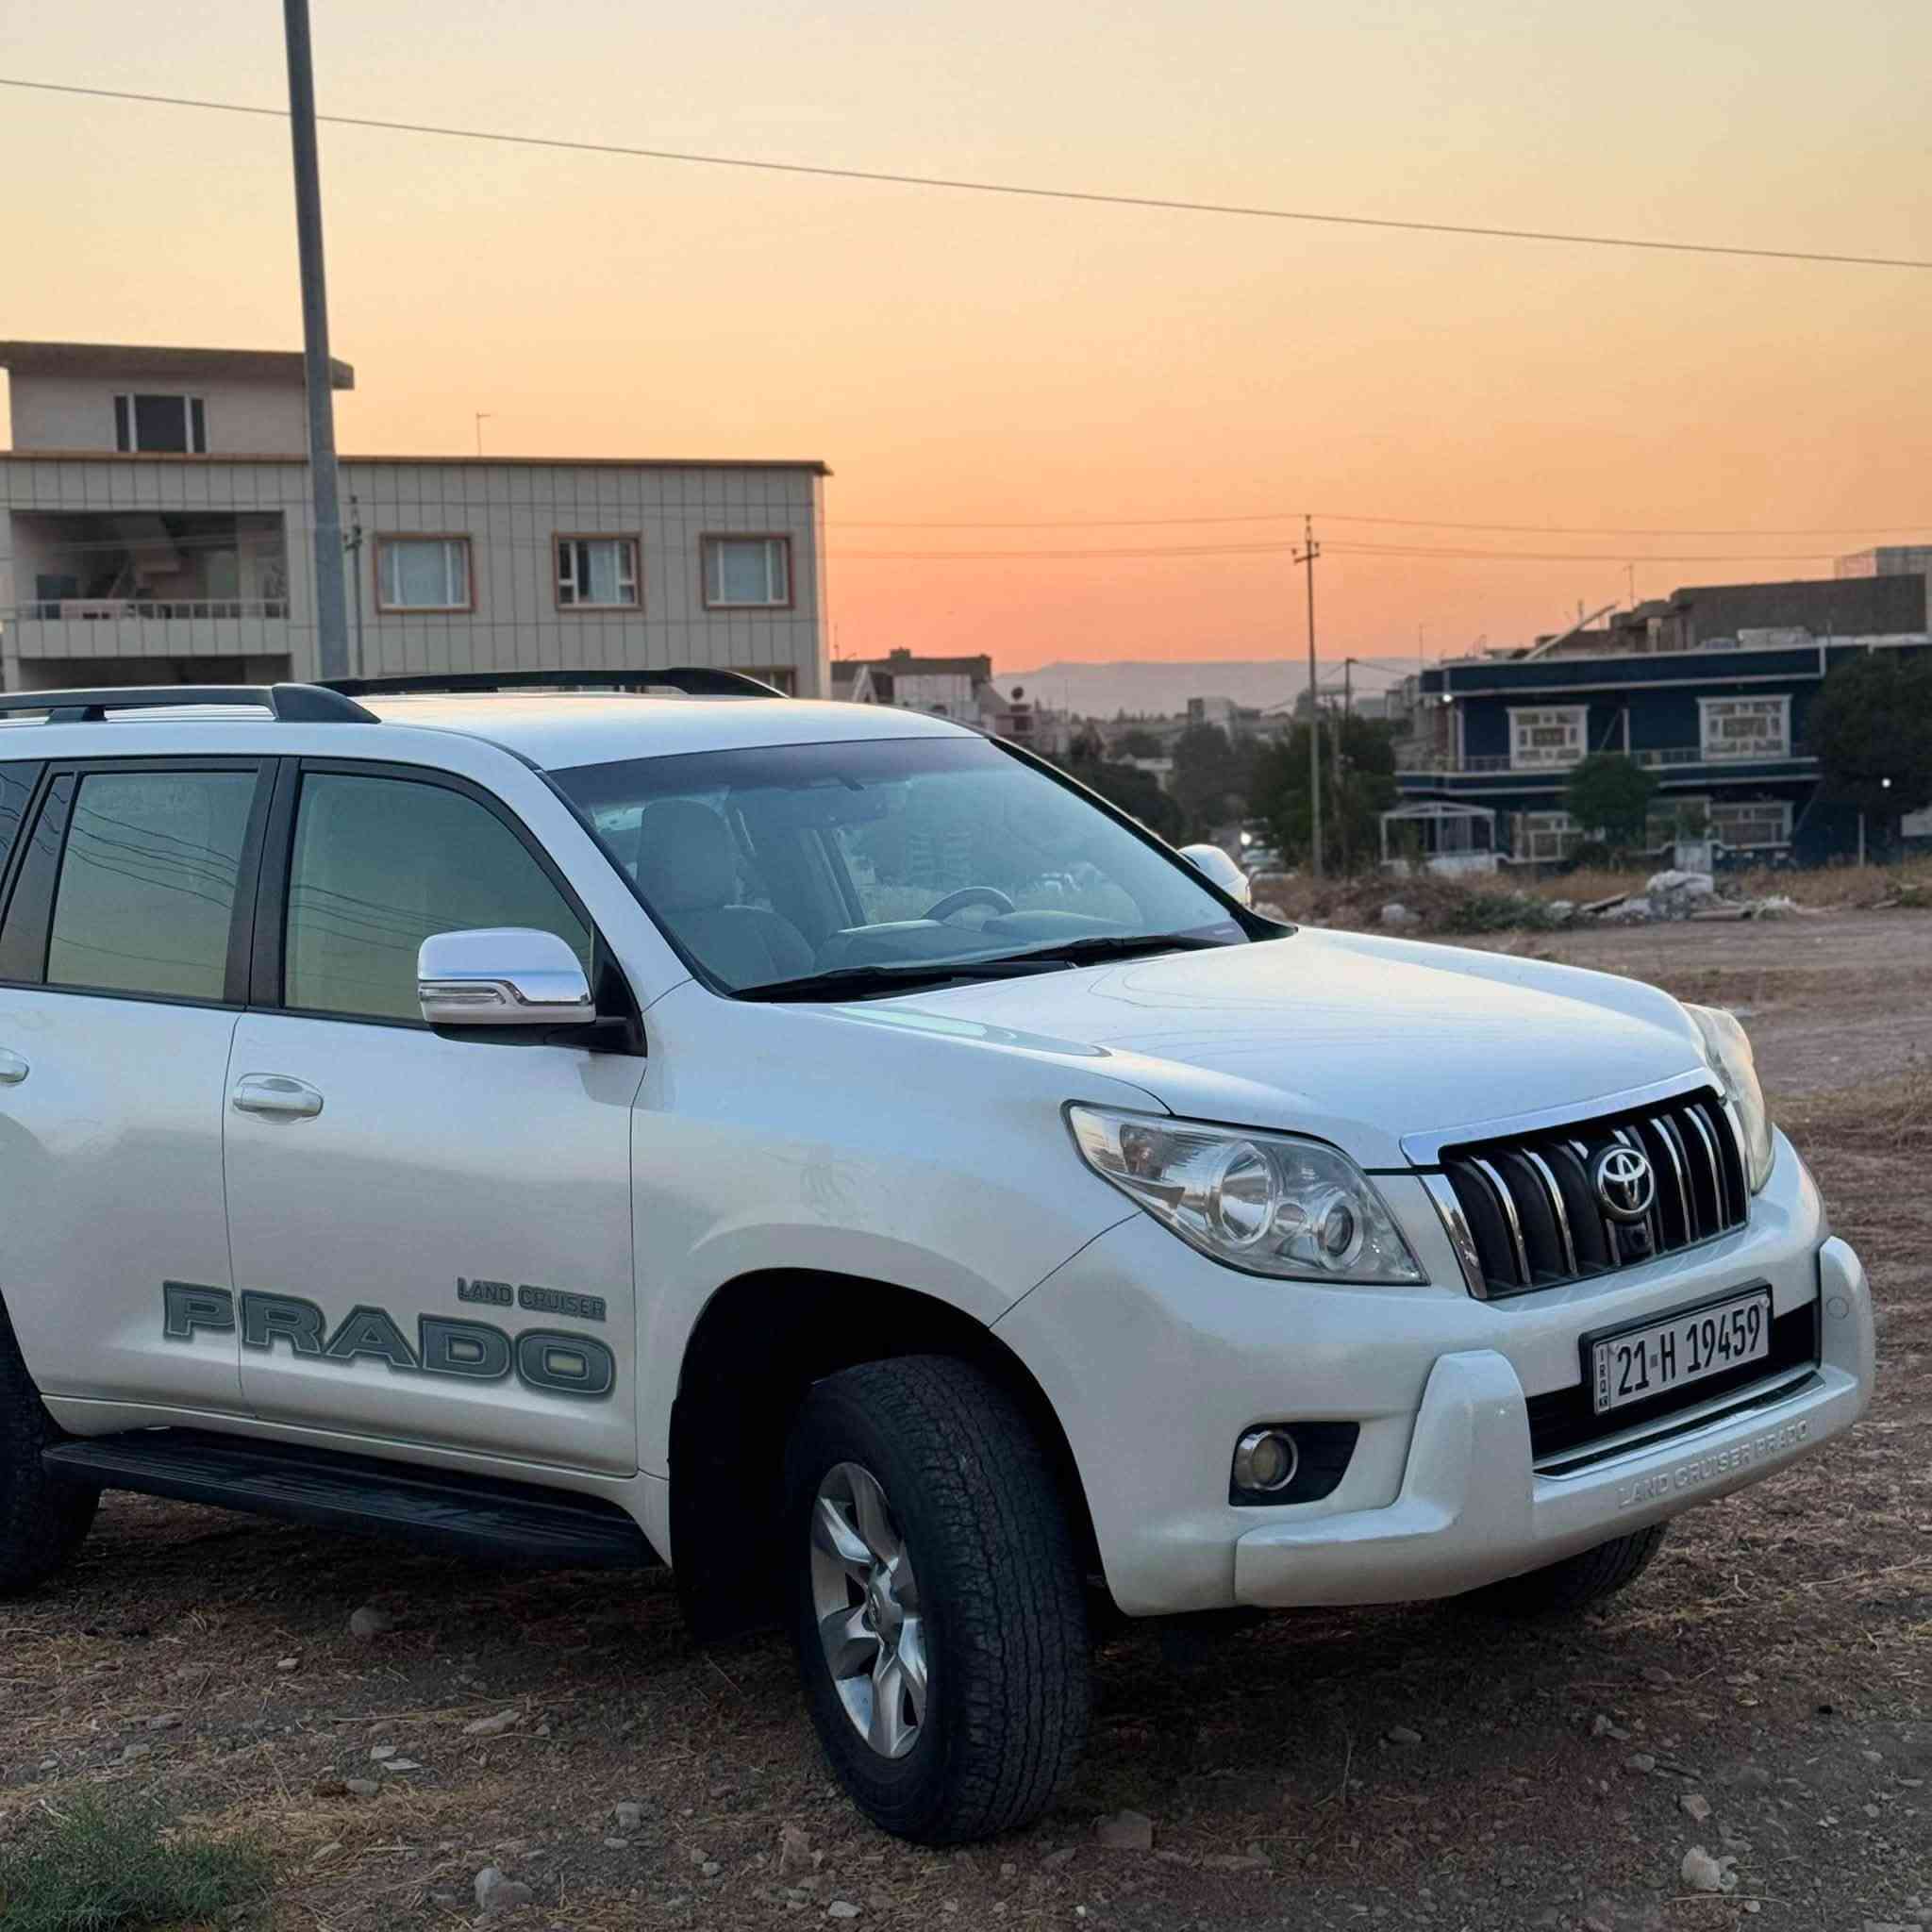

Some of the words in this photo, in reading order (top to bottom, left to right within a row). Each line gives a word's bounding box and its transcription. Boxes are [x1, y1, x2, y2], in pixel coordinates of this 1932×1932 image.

[163, 1280, 617, 1400] PRADO
[458, 1277, 514, 1307] LAND
[518, 1284, 608, 1322] CRUISER
[1617, 1340, 1650, 1396] 21
[1659, 1331, 1675, 1382] H
[1686, 1305, 1760, 1374] 19459
[1618, 1474, 1669, 1507] LAND
[1674, 1444, 1751, 1488] CRUISER
[1754, 1420, 1808, 1460] PRADO
